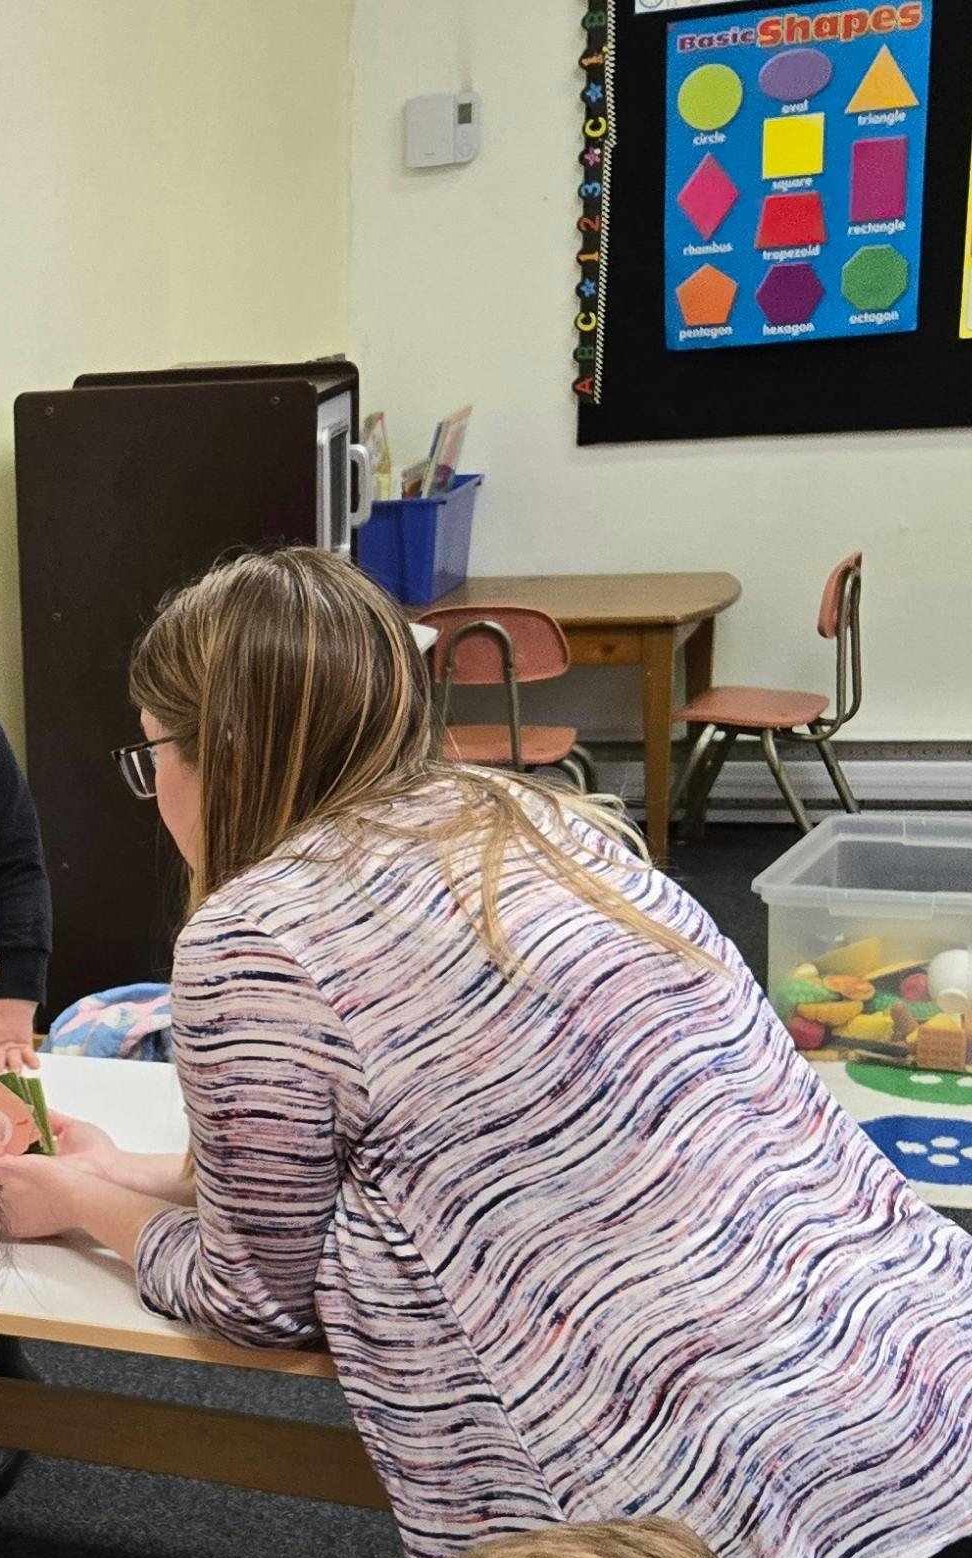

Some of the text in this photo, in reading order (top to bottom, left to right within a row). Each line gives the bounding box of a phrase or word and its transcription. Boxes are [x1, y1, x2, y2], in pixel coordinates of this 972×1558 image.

[677, 2, 922, 51] Basic Shapes
[781, 100, 809, 114] oval
[857, 110, 906, 126] triangle
[692, 131, 727, 146] circle
[772, 176, 813, 191] square
[847, 218, 906, 236] rectangle
[683, 241, 734, 256] rhombus
[762, 244, 821, 261] trapezoid
[849, 311, 900, 325] octagon
[678, 326, 733, 341] pentagon
[762, 322, 815, 337] hexagon
